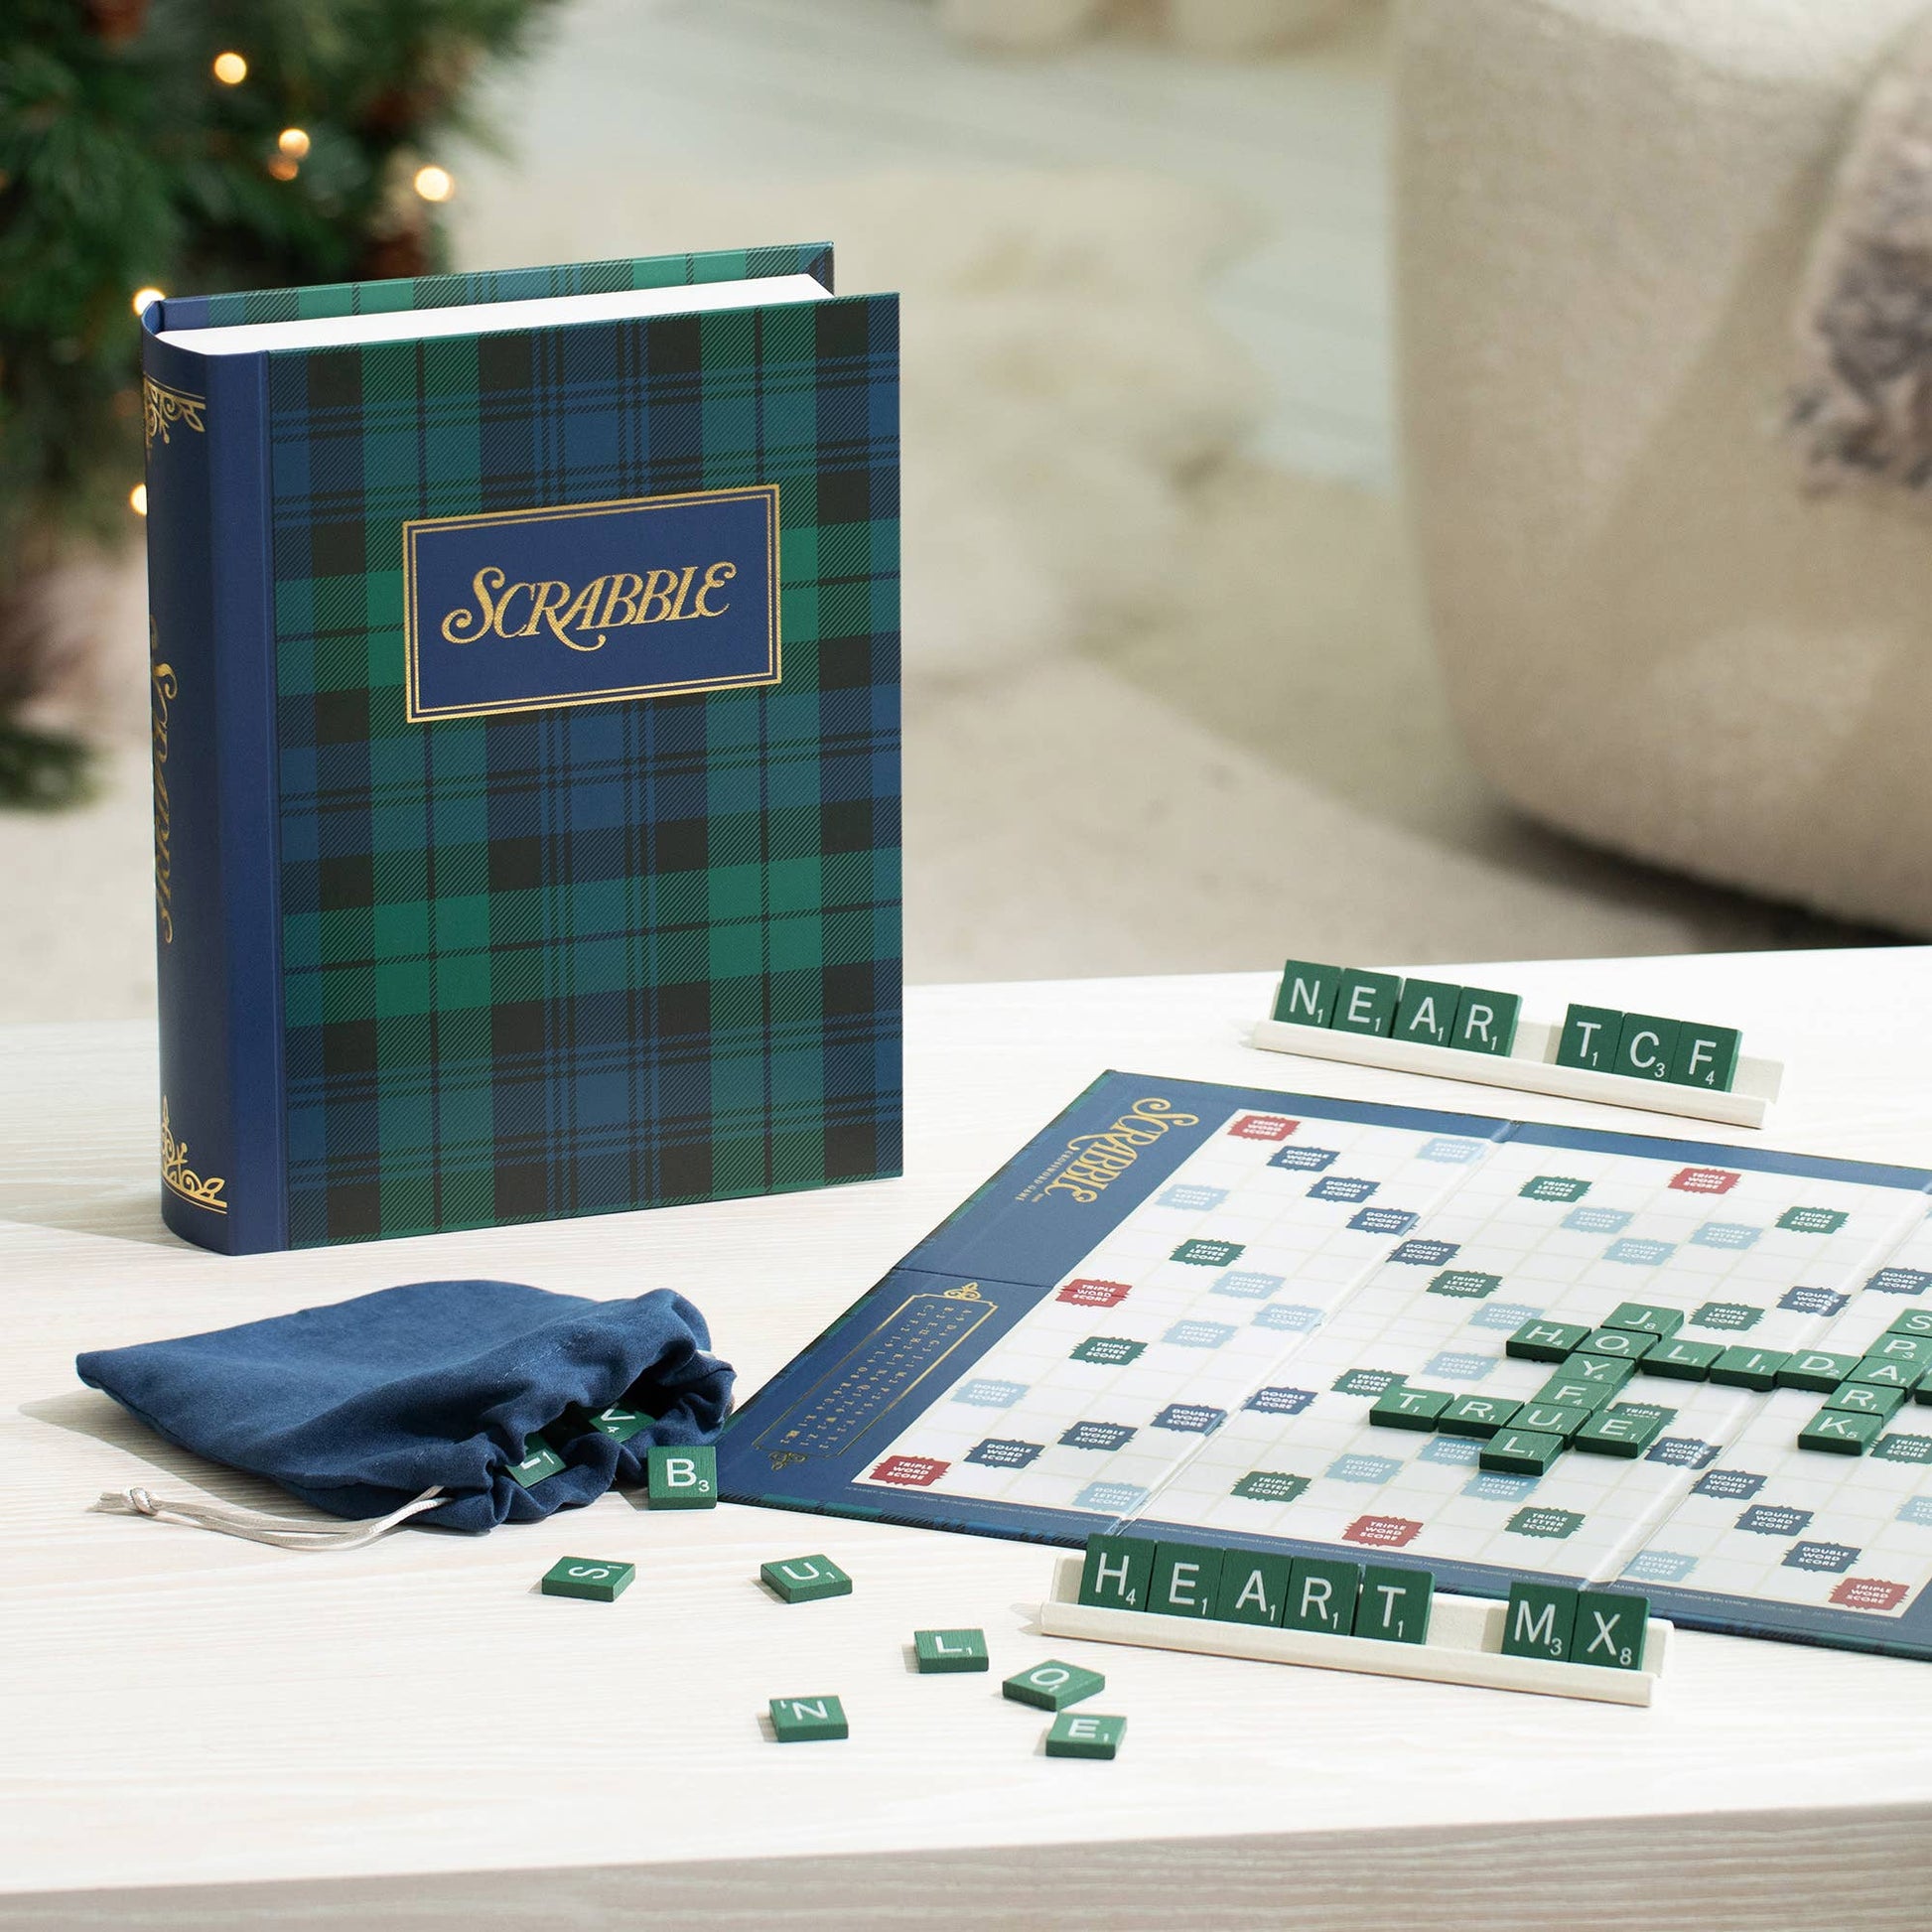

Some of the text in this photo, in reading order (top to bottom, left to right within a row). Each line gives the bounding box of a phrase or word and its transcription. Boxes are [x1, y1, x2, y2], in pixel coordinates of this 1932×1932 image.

[441, 561, 737, 651] SCRABBLE
[1044, 1097, 1199, 1202] SCRABBLE
[1365, 1211, 1410, 1220] DOUBLE
[1880, 1271, 1925, 1280] DOUBLE
[1445, 1279, 1483, 1288] LETTER
[1084, 1350, 1123, 1359] SCORE
[1355, 1373, 1393, 1382] TRIPLE
[1260, 1390, 1307, 1399] DOUBLE
[1254, 1400, 1294, 1409] SCORE
[1171, 1408, 1217, 1418] DOUBLE
[1165, 1418, 1204, 1427] SCORE
[1079, 1426, 1126, 1435] DOUBLE
[1077, 1431, 1117, 1440] WORD
[1072, 1436, 1112, 1445] SCORE
[986, 1444, 1033, 1452] DOUBLE
[1890, 1444, 1928, 1453] LETTER
[979, 1453, 1019, 1462] SCORE
[984, 1449, 1024, 1457] WORD
[890, 1465, 930, 1474] WORD
[1256, 1476, 1295, 1485] TRIPLE
[1708, 1473, 1755, 1483] DOUBLE
[1250, 1481, 1291, 1490] LETTER
[1707, 1479, 1747, 1488] WORD
[1246, 1486, 1286, 1495] SCORE
[1703, 1484, 1743, 1493] SCORE
[1754, 1509, 1802, 1519] DOUBLE
[1524, 1517, 1565, 1526] LETTER
[1753, 1515, 1794, 1524] WORD
[1367, 1521, 1407, 1530] TRIPLE
[1749, 1520, 1790, 1529] SCORE
[1362, 1526, 1403, 1535] WORD
[1357, 1531, 1398, 1540] SCORE
[1801, 1546, 1850, 1556] DOUBLE
[1800, 1552, 1842, 1561] WORD
[1796, 1557, 1837, 1566] SCORE
[1853, 1584, 1893, 1592] TRIPLE
[1849, 1588, 1890, 1598] WORD
[1845, 1594, 1885, 1603] SCORE
